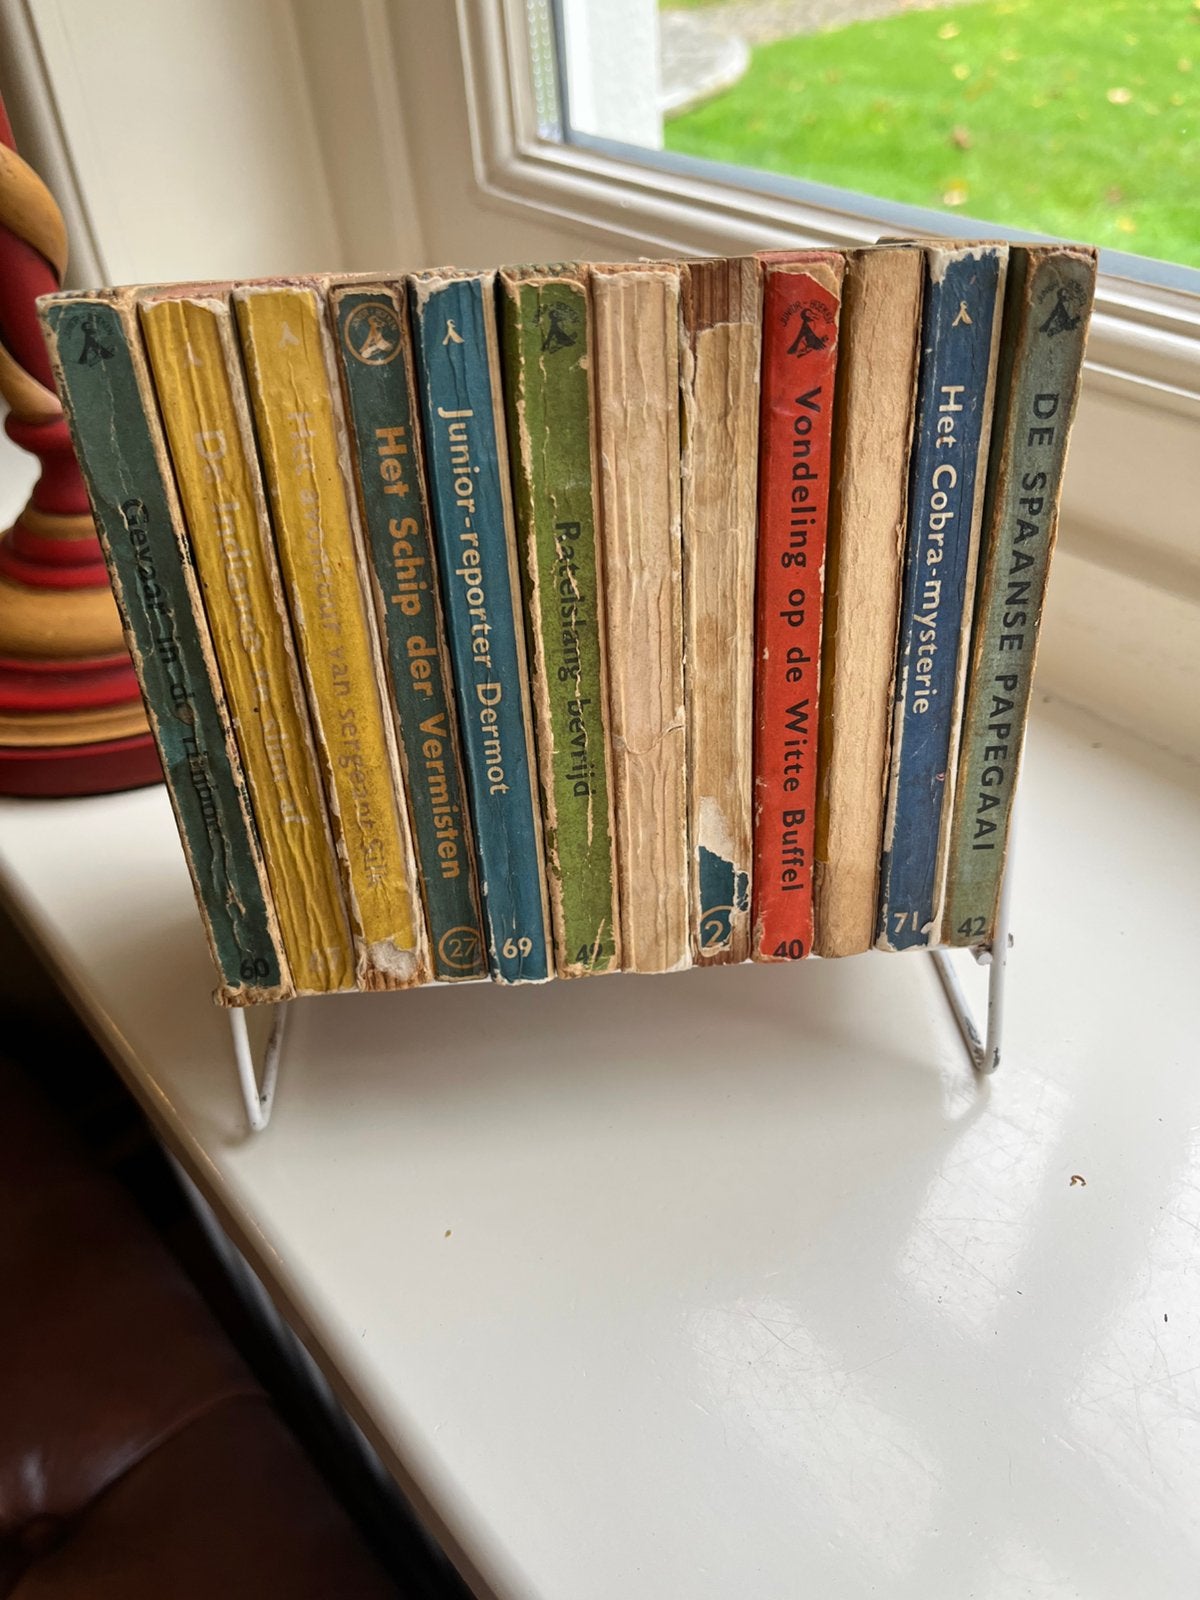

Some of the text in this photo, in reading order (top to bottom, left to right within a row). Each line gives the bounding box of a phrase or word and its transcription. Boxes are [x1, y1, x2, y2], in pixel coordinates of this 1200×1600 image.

[122, 498, 168, 615] Gevaar
[157, 636, 182, 664] in
[437, 406, 510, 796] Junior-reporter Dermot
[912, 385, 965, 714] Het Cobra-mysterie
[328, 645, 351, 698] van
[375, 426, 461, 879] Het Schip der Vermisten
[555, 521, 597, 798] Ratelslang bevrijd
[779, 386, 822, 892] Vondeling op de Witte Buffel
[972, 393, 1059, 850] DE SPAANSE PAPEGAAI
[338, 707, 376, 829] sergeant
[240, 957, 270, 980] 60
[448, 938, 477, 958] 27
[502, 937, 533, 959] 69
[773, 939, 804, 960] 40
[894, 911, 918, 933] 71
[957, 917, 986, 937] 42
